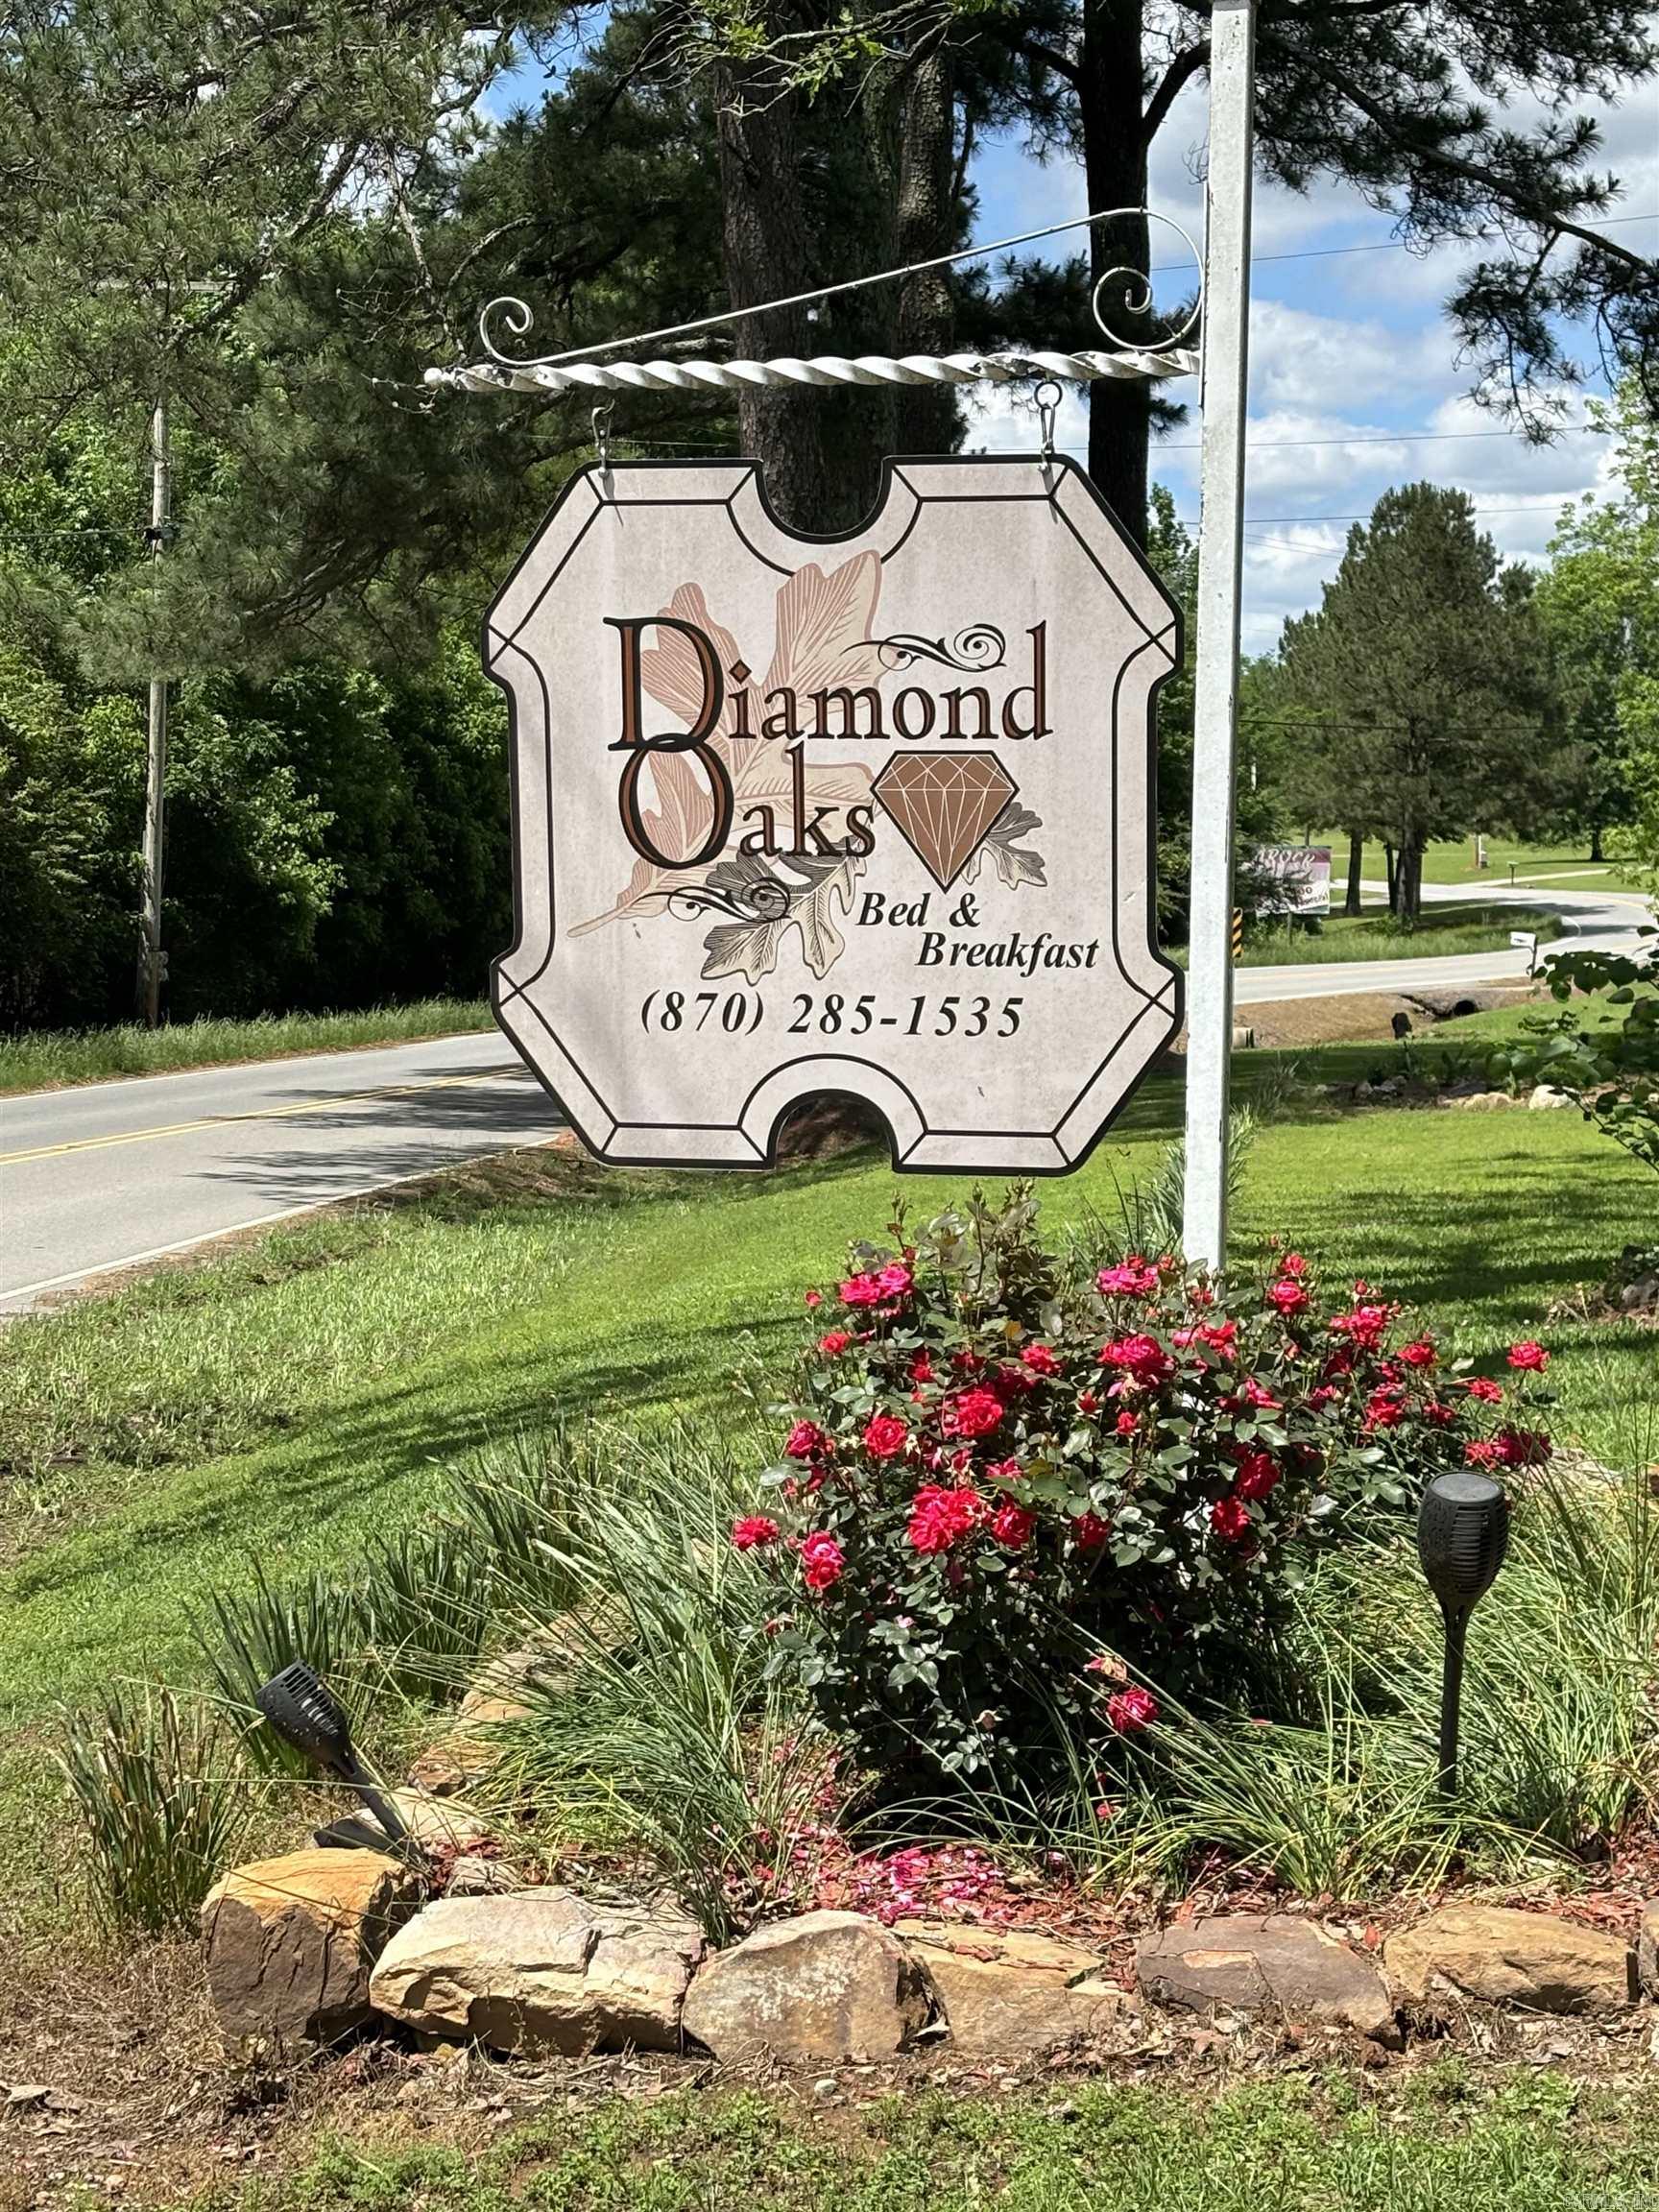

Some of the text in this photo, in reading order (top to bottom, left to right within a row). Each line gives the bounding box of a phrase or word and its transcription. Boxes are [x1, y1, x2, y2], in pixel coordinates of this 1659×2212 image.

[602, 615, 1054, 751] Diamond
[617, 733, 877, 871] Oaks
[855, 892, 980, 928] Bed &
[916, 932, 1099, 978] Breakfast
[640, 991, 1024, 1038] (870) 285-1535
